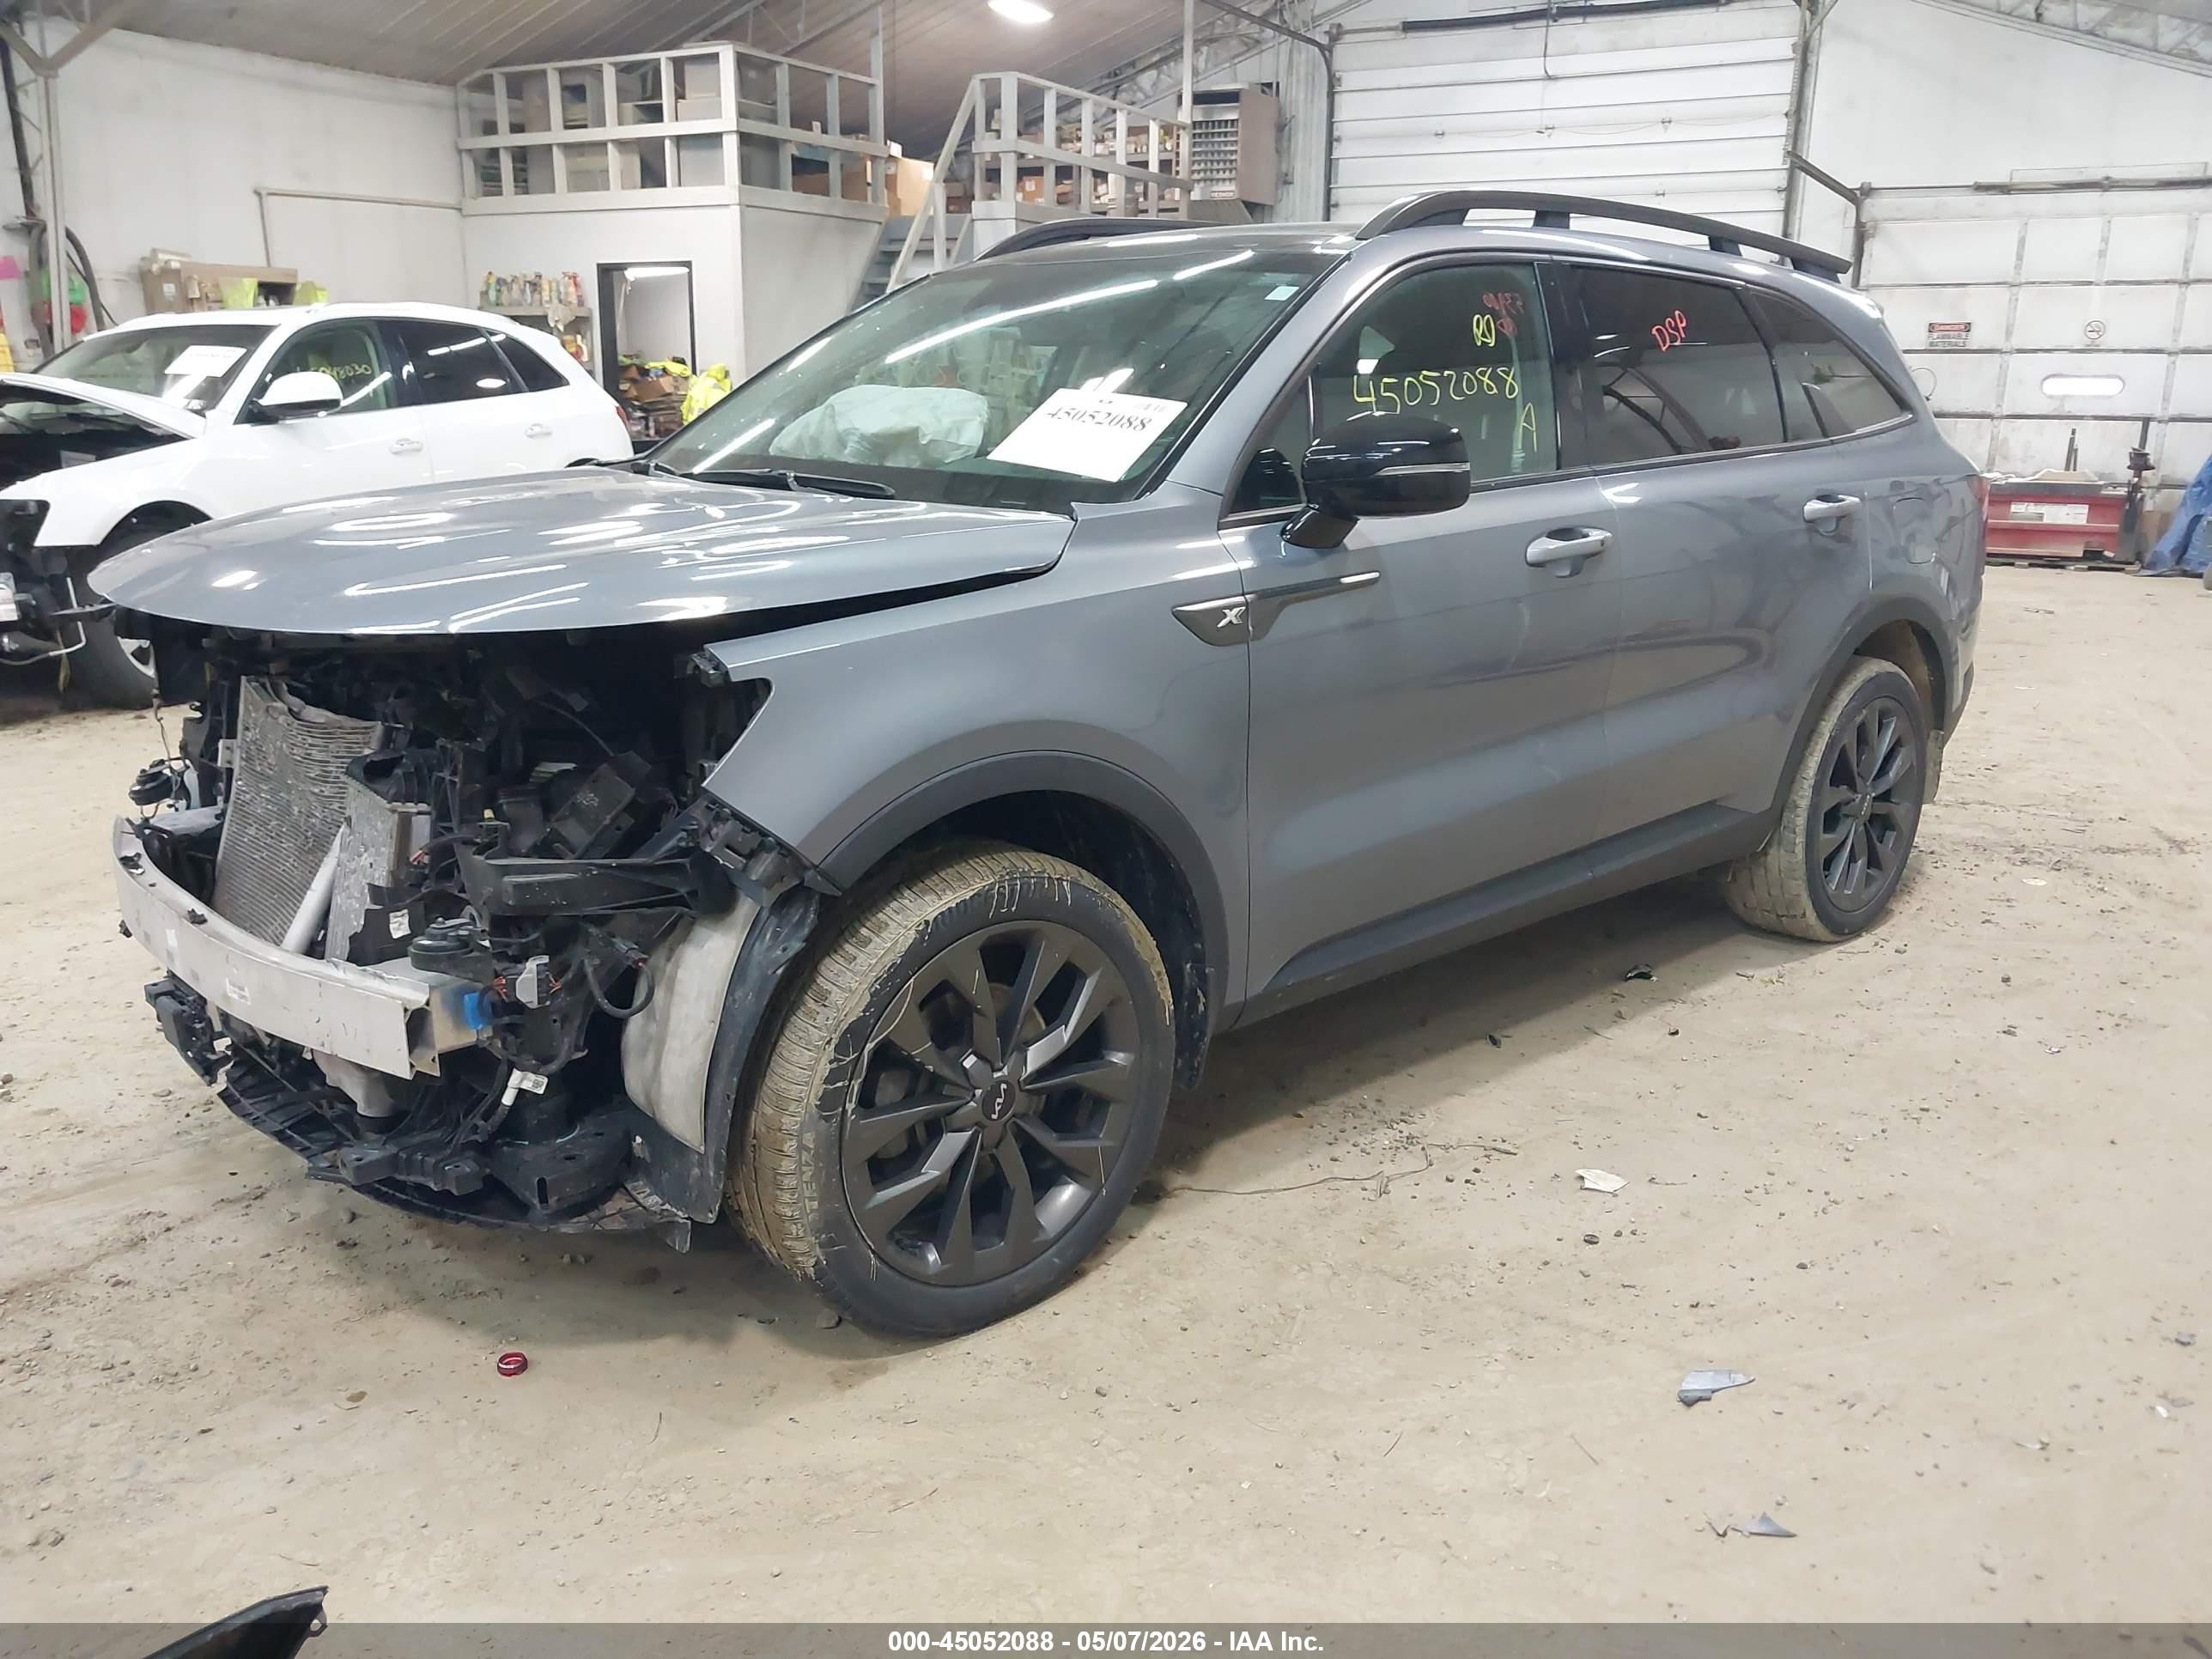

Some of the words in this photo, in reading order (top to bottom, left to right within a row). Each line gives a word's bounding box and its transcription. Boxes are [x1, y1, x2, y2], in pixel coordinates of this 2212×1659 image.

[1651, 310, 1686, 351] DSP
[1352, 366, 1519, 415] 45052088
[1046, 407, 1153, 432] 45052088
[1517, 402, 1537, 453] A
